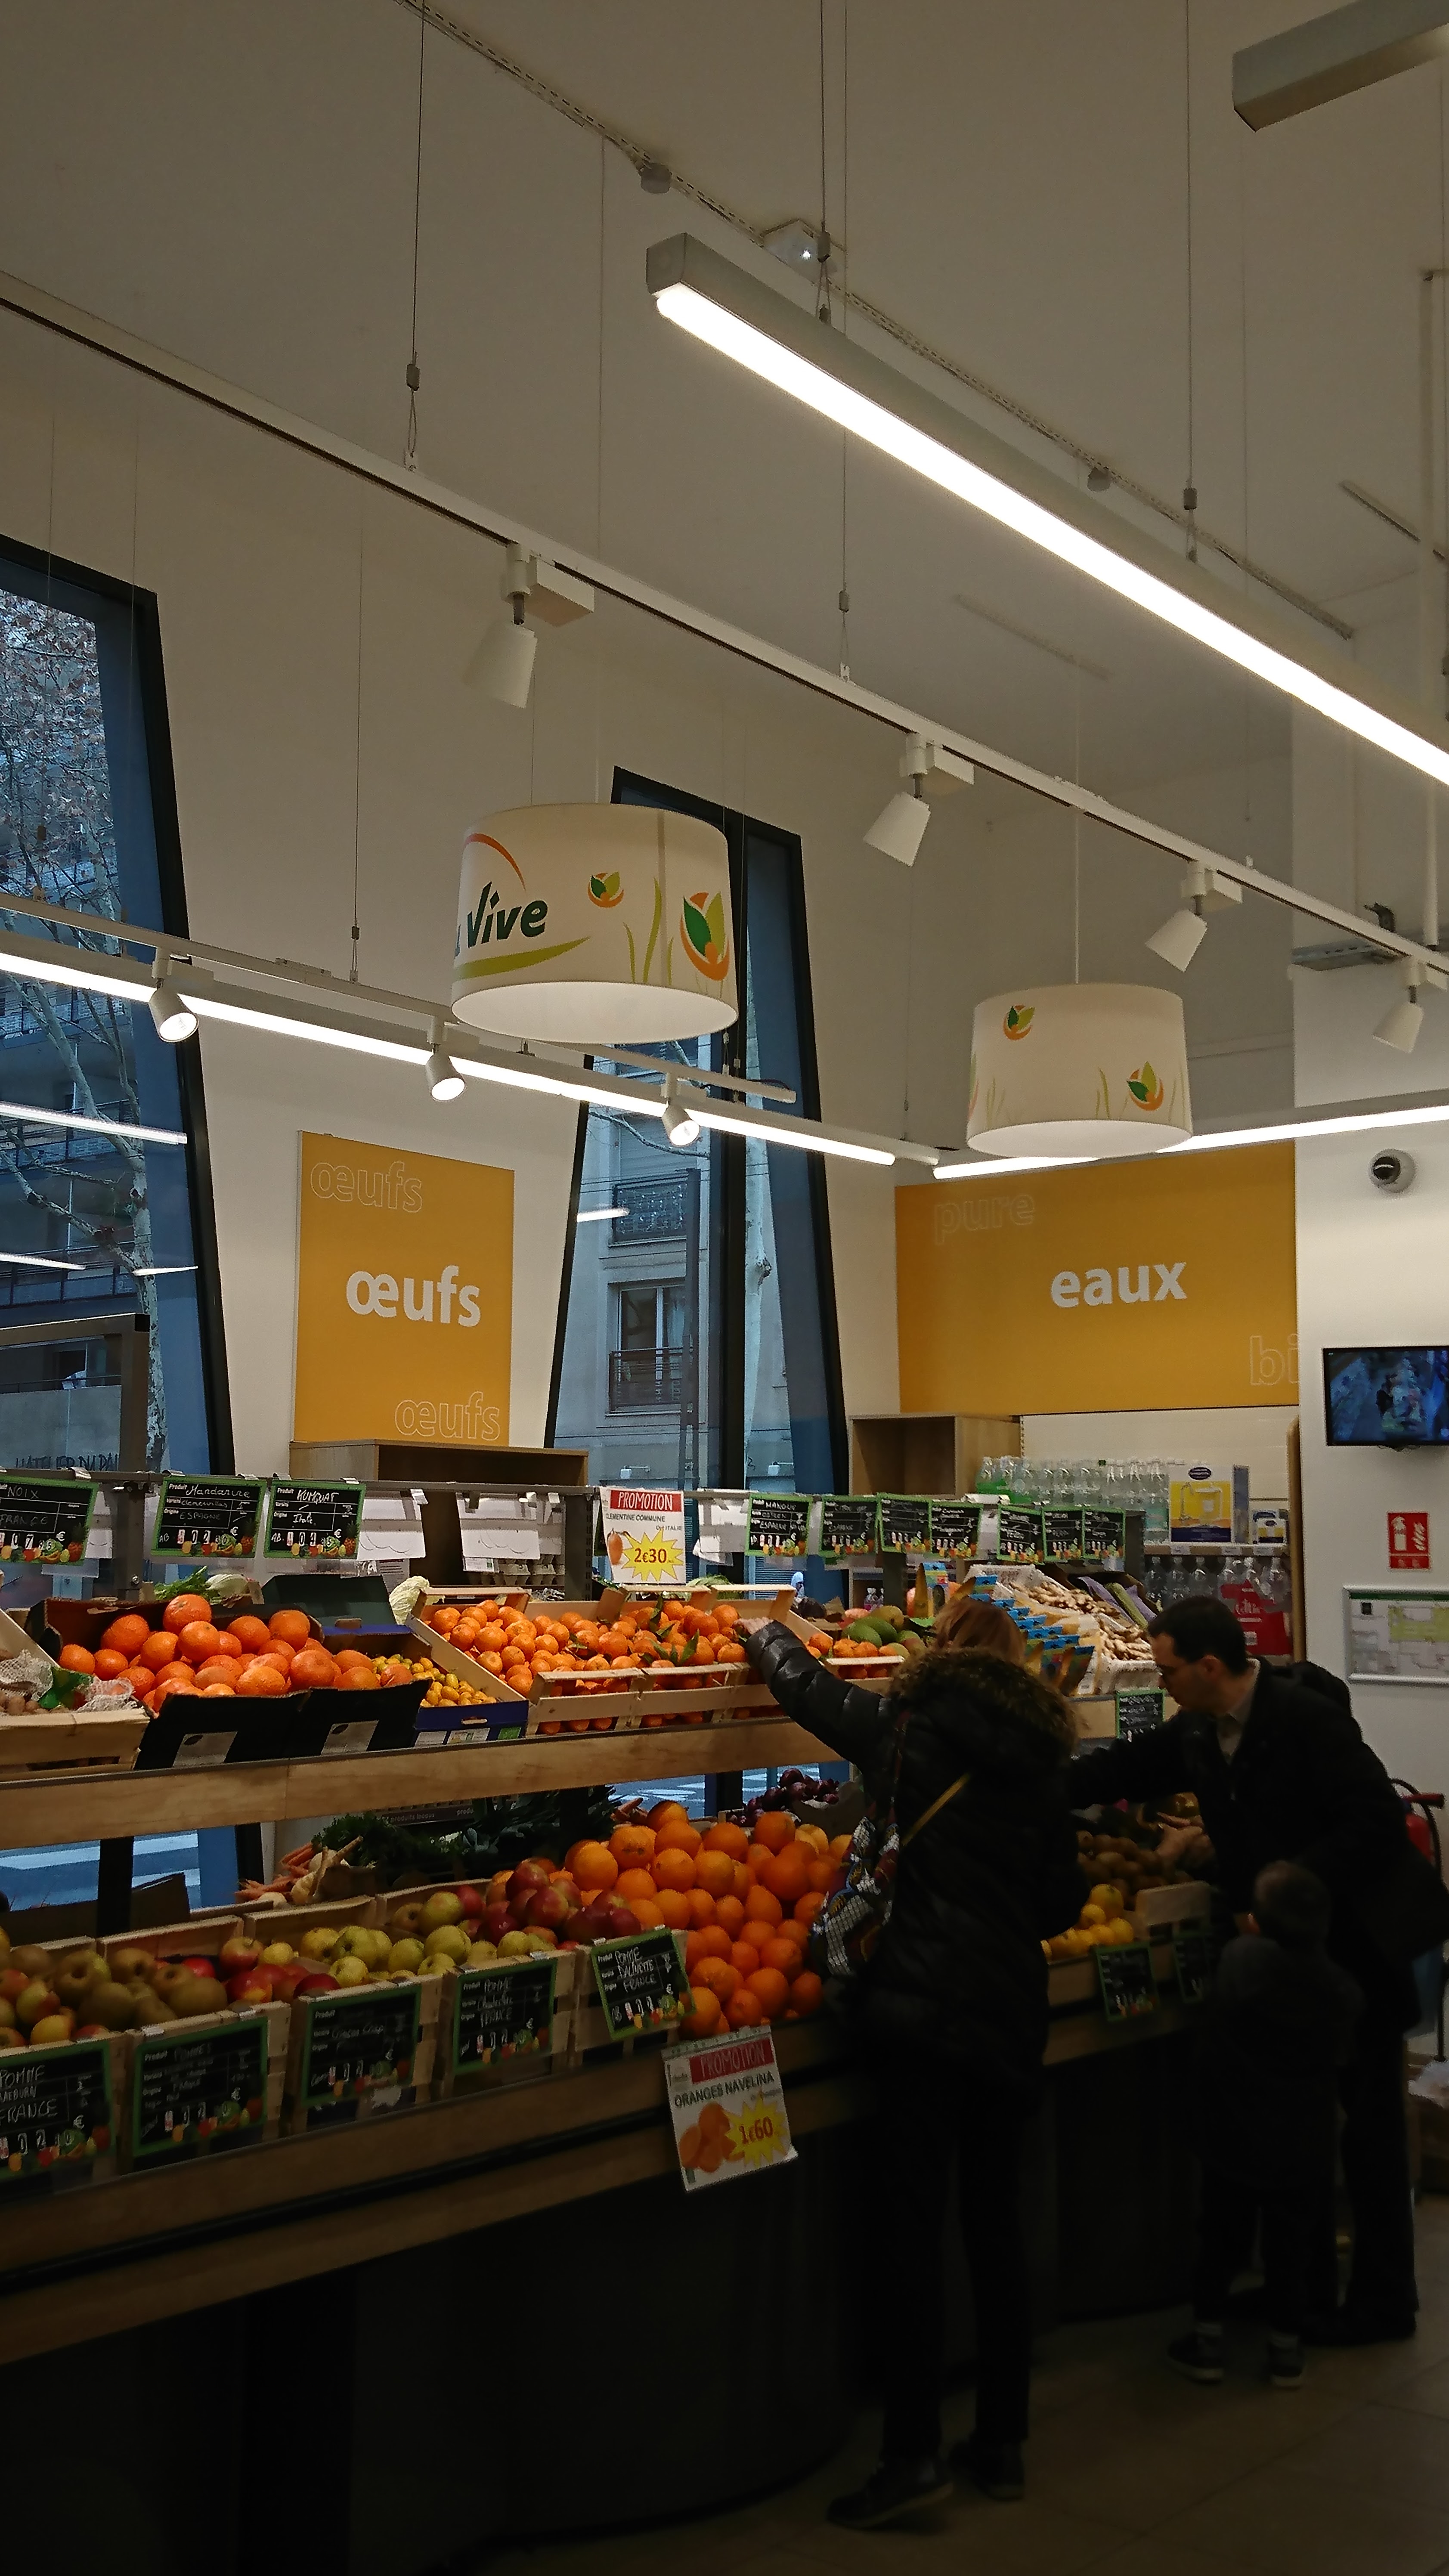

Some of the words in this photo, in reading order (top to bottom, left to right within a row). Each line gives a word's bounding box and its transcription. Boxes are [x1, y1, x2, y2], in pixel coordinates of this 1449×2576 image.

[467, 881, 548, 948] Vive
[310, 1161, 423, 1213] œufs
[934, 1192, 1037, 1245] pure
[346, 1265, 481, 1327] œufs
[1050, 1261, 1187, 1308] eaux
[394, 1390, 500, 1441] œufs
[8, 1486, 39, 1499] NOIX
[297, 1489, 340, 1505] KUMQUAT
[618, 1492, 673, 1511] PROMOTION
[0, 1514, 48, 1526] FRANCE
[180, 1511, 221, 1520] ESPAGNE
[606, 1513, 635, 1521] CLEMENTINE
[636, 1514, 666, 1522] COMMUNE
[634, 1548, 667, 1563] 2€30
[700, 2042, 765, 2078] PROMOTION
[0, 2065, 45, 2088] POMME
[674, 2083, 724, 2108] ORANGES
[724, 2070, 775, 2095] NAVELINA
